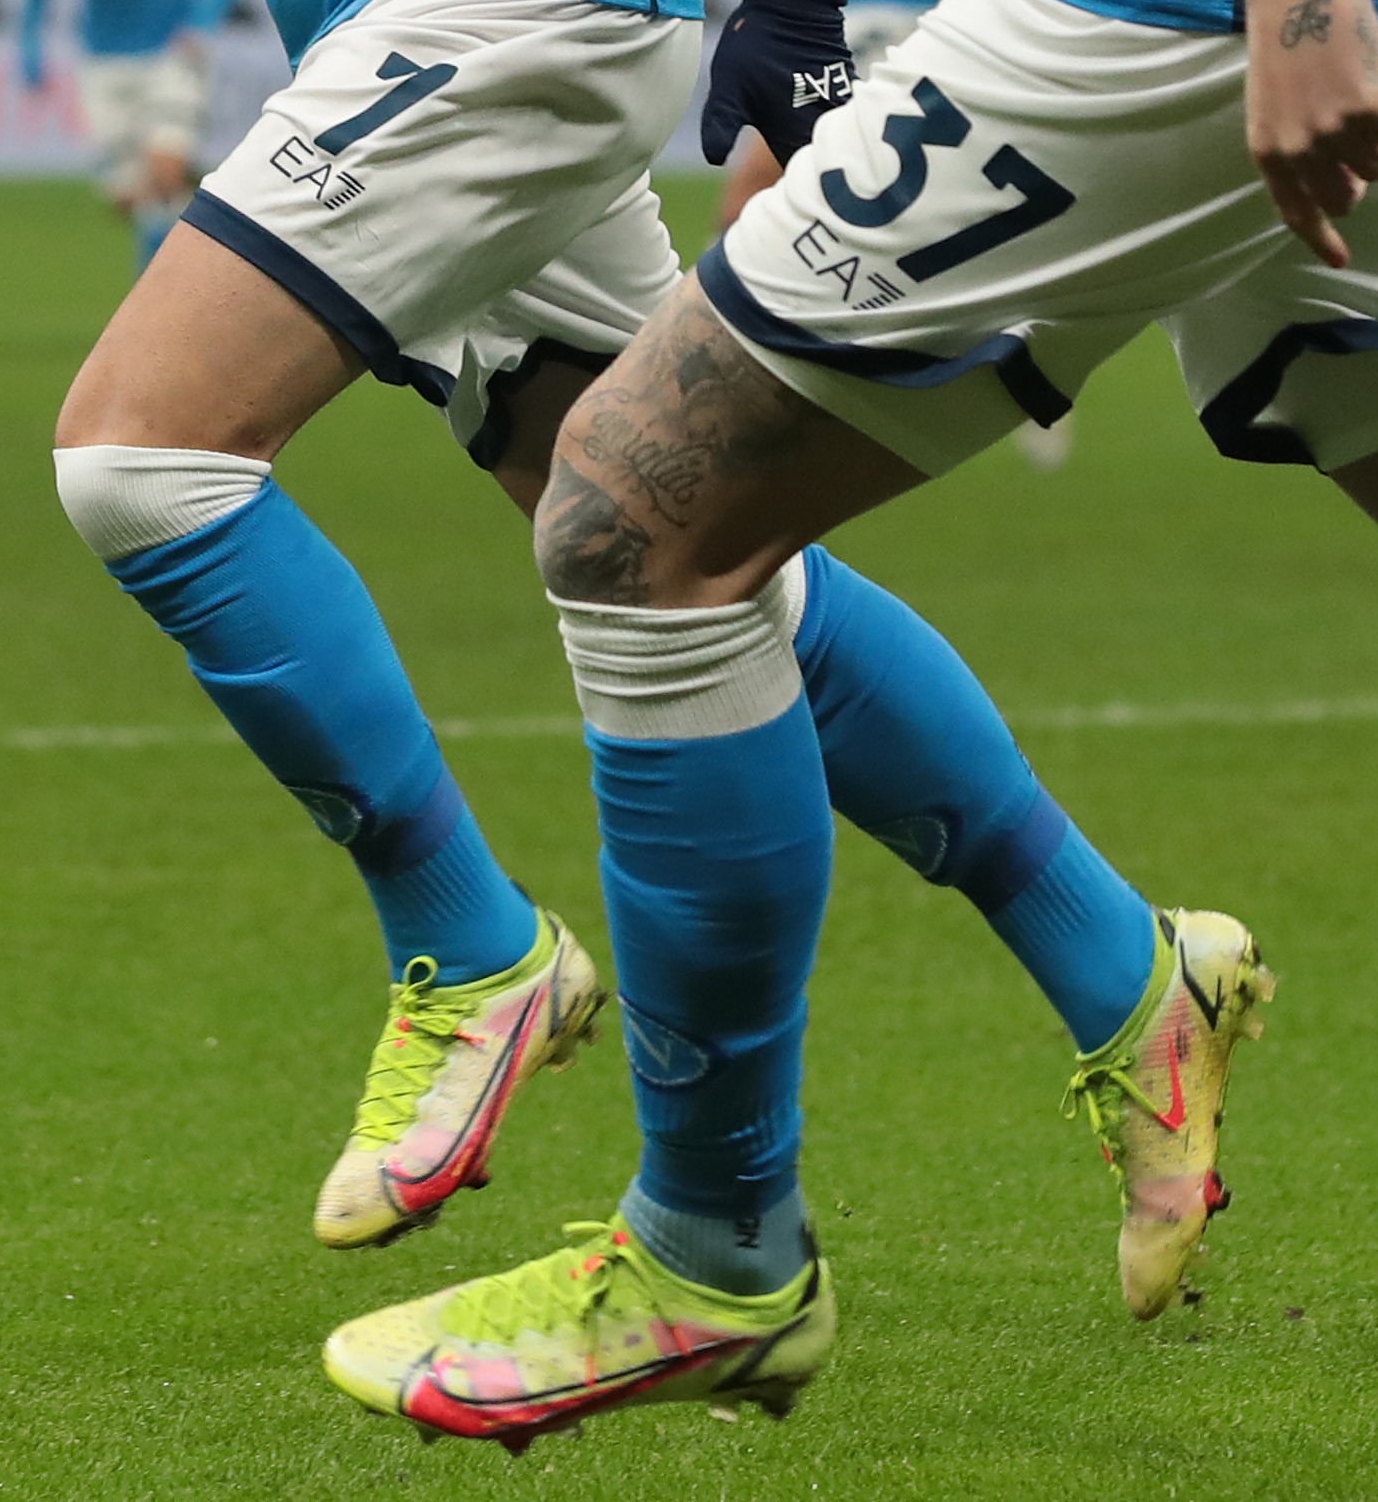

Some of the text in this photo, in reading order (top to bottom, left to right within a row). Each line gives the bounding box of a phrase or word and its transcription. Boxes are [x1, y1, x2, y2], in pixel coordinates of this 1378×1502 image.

[313, 51, 459, 157] 7
[269, 135, 366, 211] EA7
[820, 75, 1077, 283] 37
[792, 219, 906, 311] EA7
